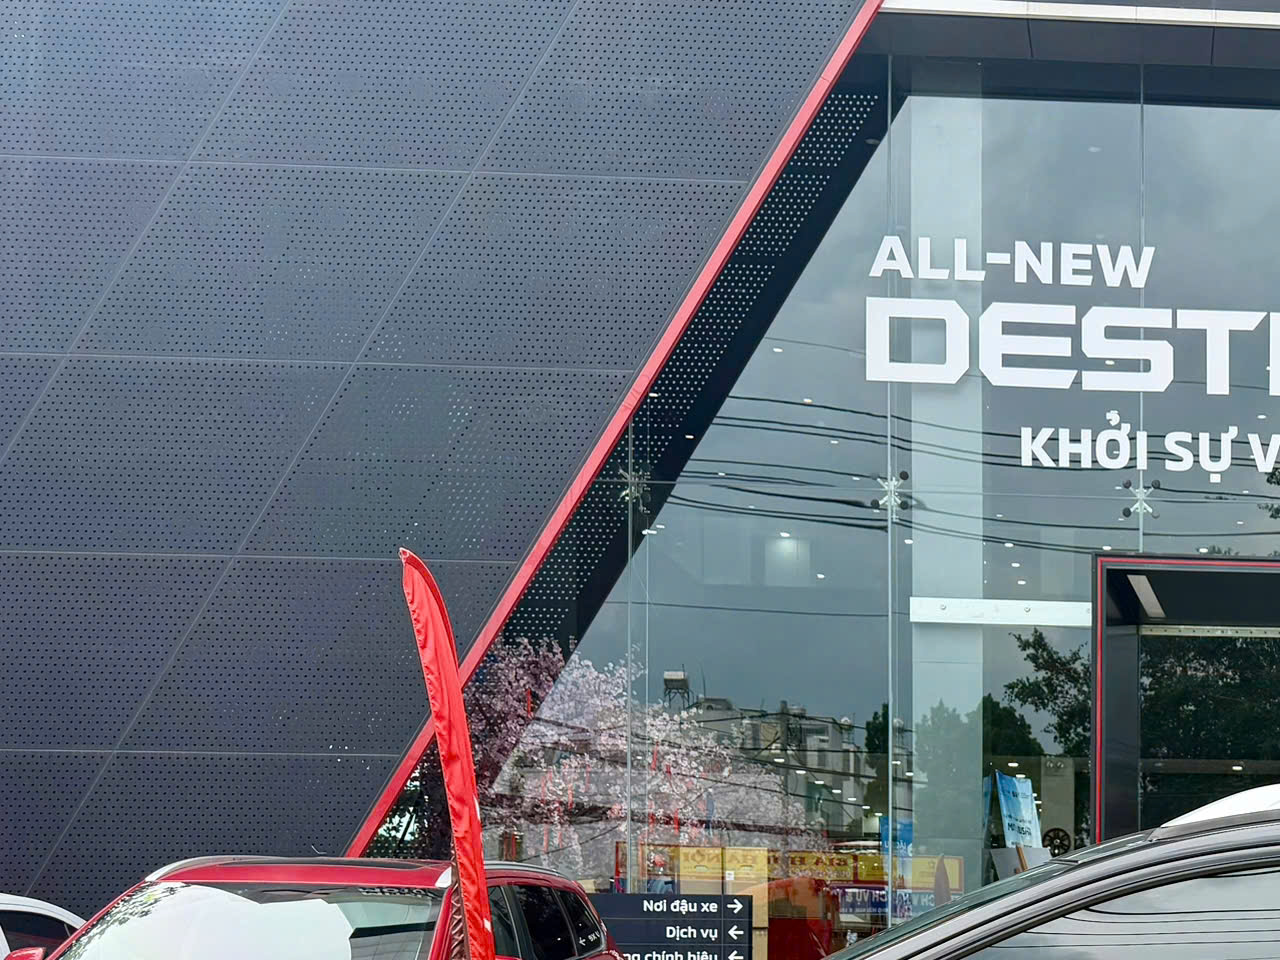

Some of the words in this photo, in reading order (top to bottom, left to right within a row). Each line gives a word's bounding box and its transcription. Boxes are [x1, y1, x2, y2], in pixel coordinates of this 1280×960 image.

[869, 236, 1155, 288] ALL-NEW
[1020, 410, 1148, 471] KHỞI
[1164, 426, 1239, 483] SỰ
[643, 900, 667, 912] Nơi
[670, 899, 698, 915] đậu
[701, 902, 718, 912] xe
[666, 926, 697, 941] Dịch
[700, 929, 718, 941] vụ
